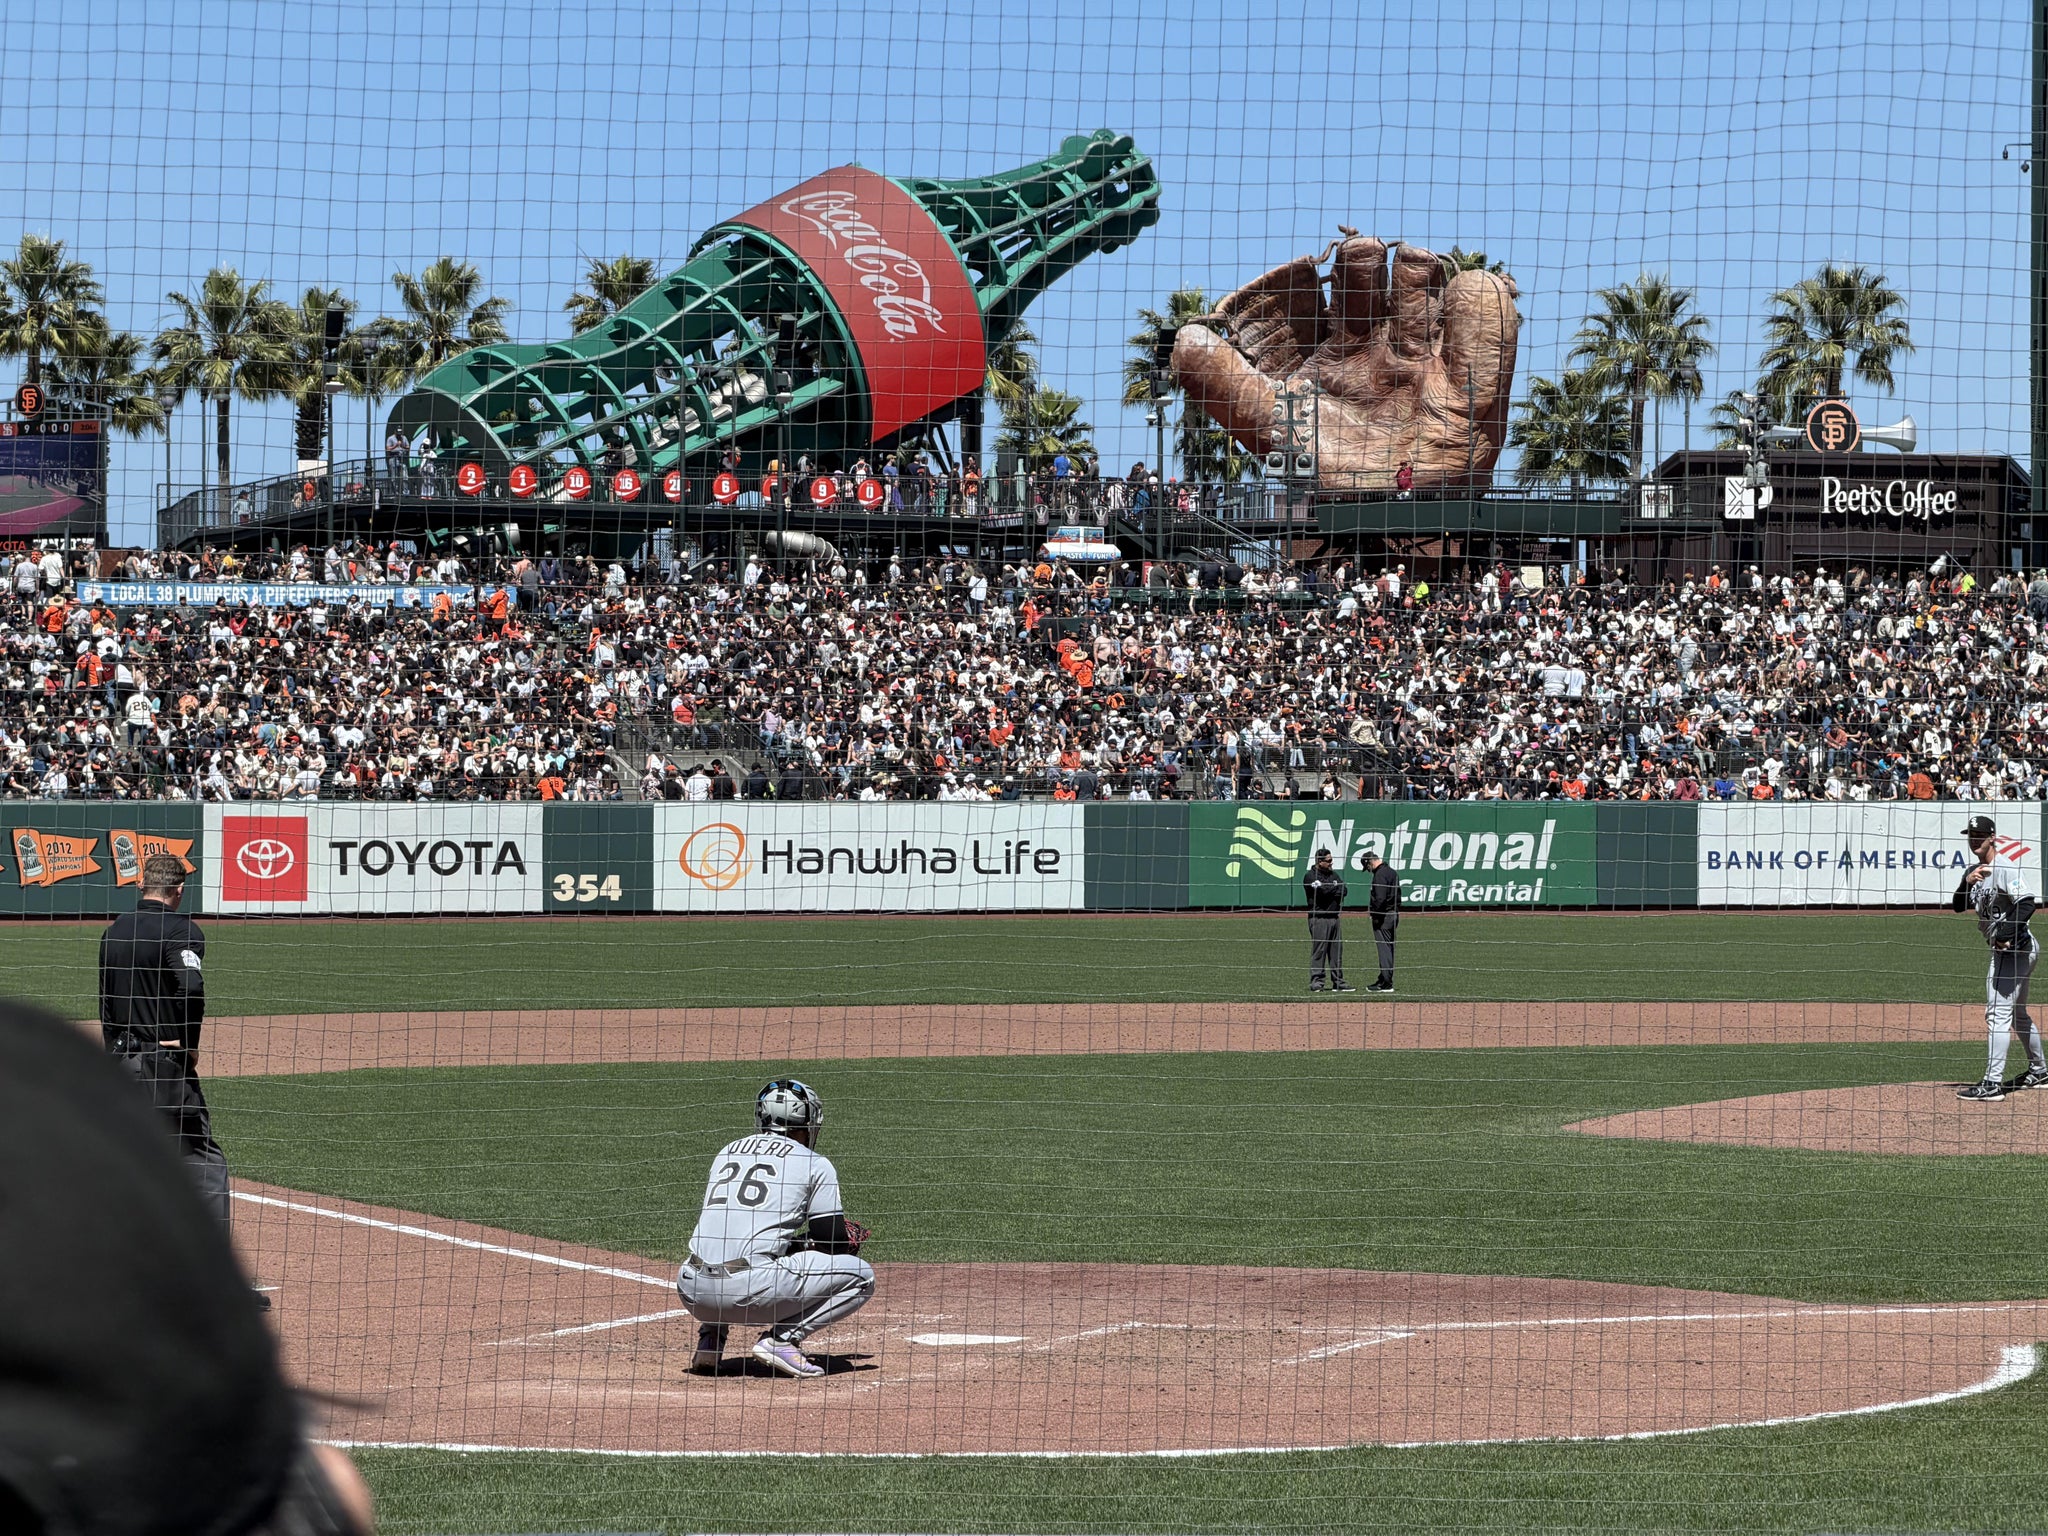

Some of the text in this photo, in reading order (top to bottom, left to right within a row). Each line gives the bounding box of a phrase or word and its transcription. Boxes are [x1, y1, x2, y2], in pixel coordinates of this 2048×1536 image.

[780, 190, 947, 343] Coca-Cola
[467, 471, 476, 484] 2
[519, 473, 527, 486] 1
[569, 475, 584, 488] 10
[619, 477, 633, 490] 16
[721, 480, 730, 494] 6
[818, 484, 827, 497] 9
[1819, 476, 1957, 520] Peet's Coffee
[111, 584, 153, 601] LOCAL
[156, 585, 172, 600] 38
[176, 585, 248, 602] PLUMBERS
[46, 842, 72, 856] 2012
[1306, 818, 1557, 871] National
[329, 840, 527, 876] TOYOTA
[762, 840, 1060, 874] Hanwha Life
[1707, 850, 1966, 869] BANK OF AMERICA
[552, 873, 622, 902] 354
[1398, 878, 1543, 902] Car Rental
[706, 1161, 777, 1208] 26
